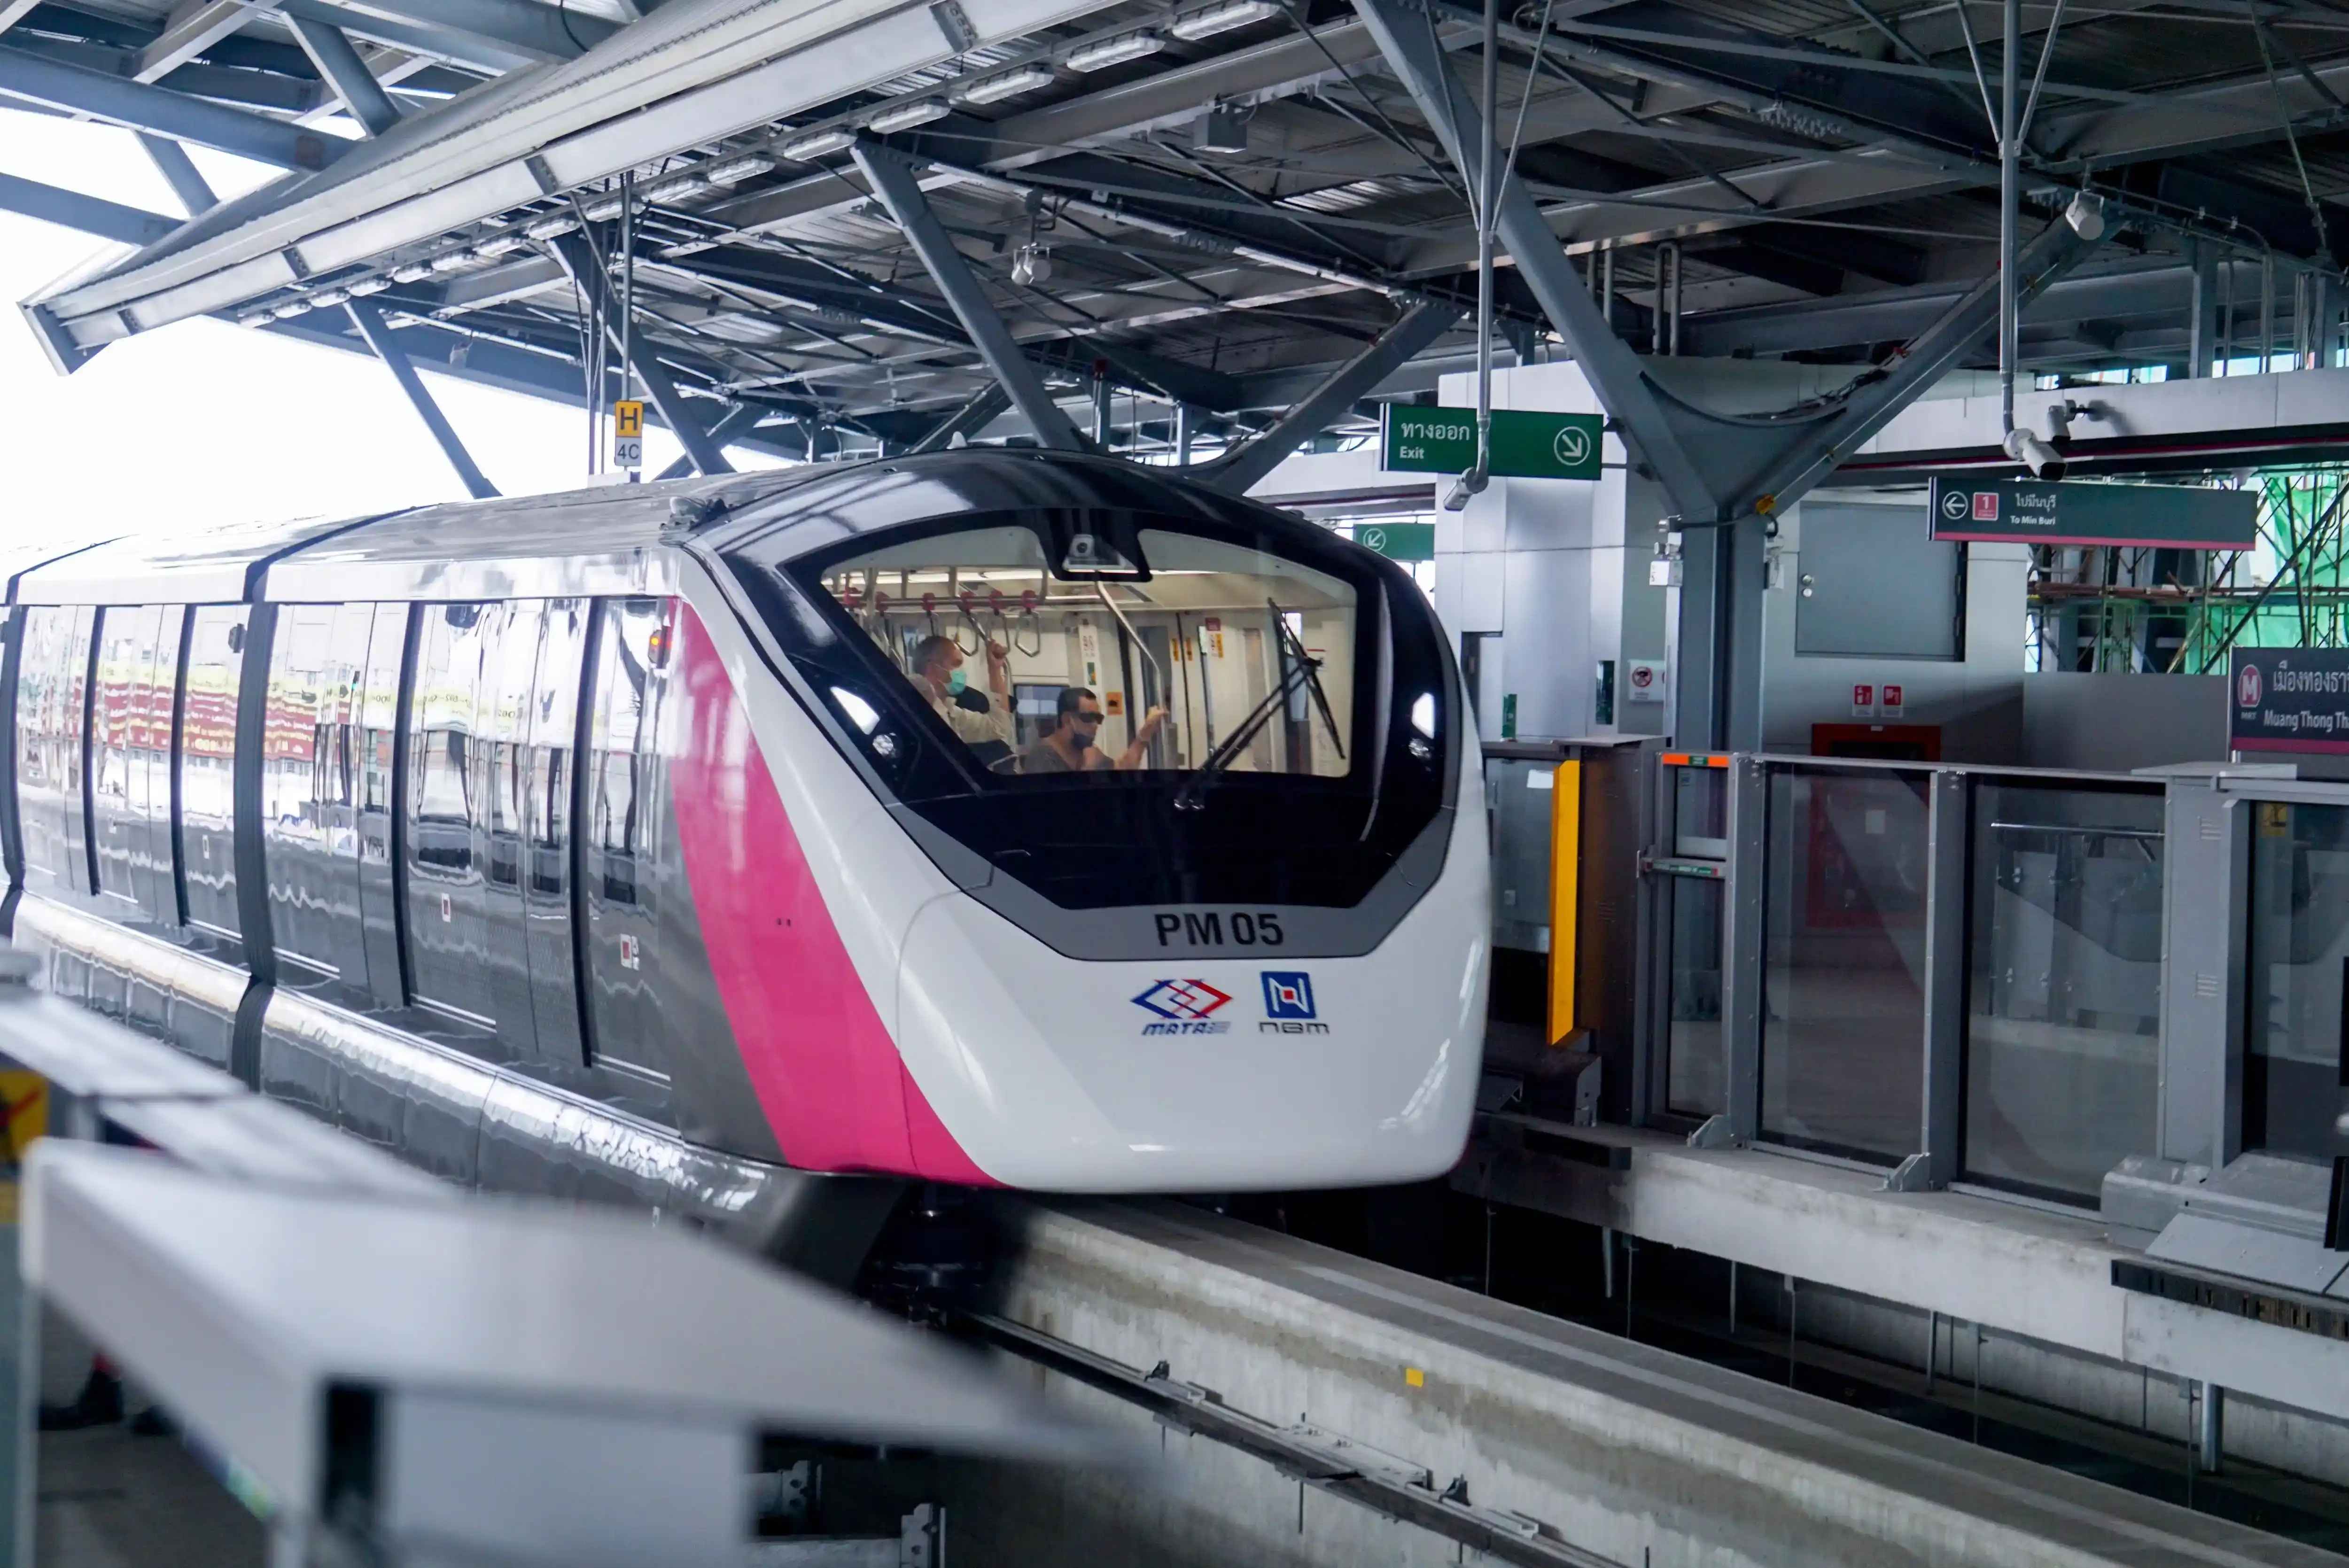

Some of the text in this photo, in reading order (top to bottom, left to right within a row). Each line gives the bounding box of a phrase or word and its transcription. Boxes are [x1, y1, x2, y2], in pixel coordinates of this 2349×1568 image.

[620, 407, 638, 430] H
[1401, 422, 1470, 441] ทางออก
[617, 444, 639, 459] 4C
[1399, 446, 1425, 459] Exit
[1982, 496, 1990, 510] 1
[2015, 493, 2056, 513] ไปมีนบุรี
[2010, 515, 2056, 525] To Min Buri
[2273, 660, 2349, 693] เมืองทองธา
[2263, 709, 2300, 731] Muang
[2300, 710, 2333, 733] Thong
[1154, 912, 1284, 946] PM 05
